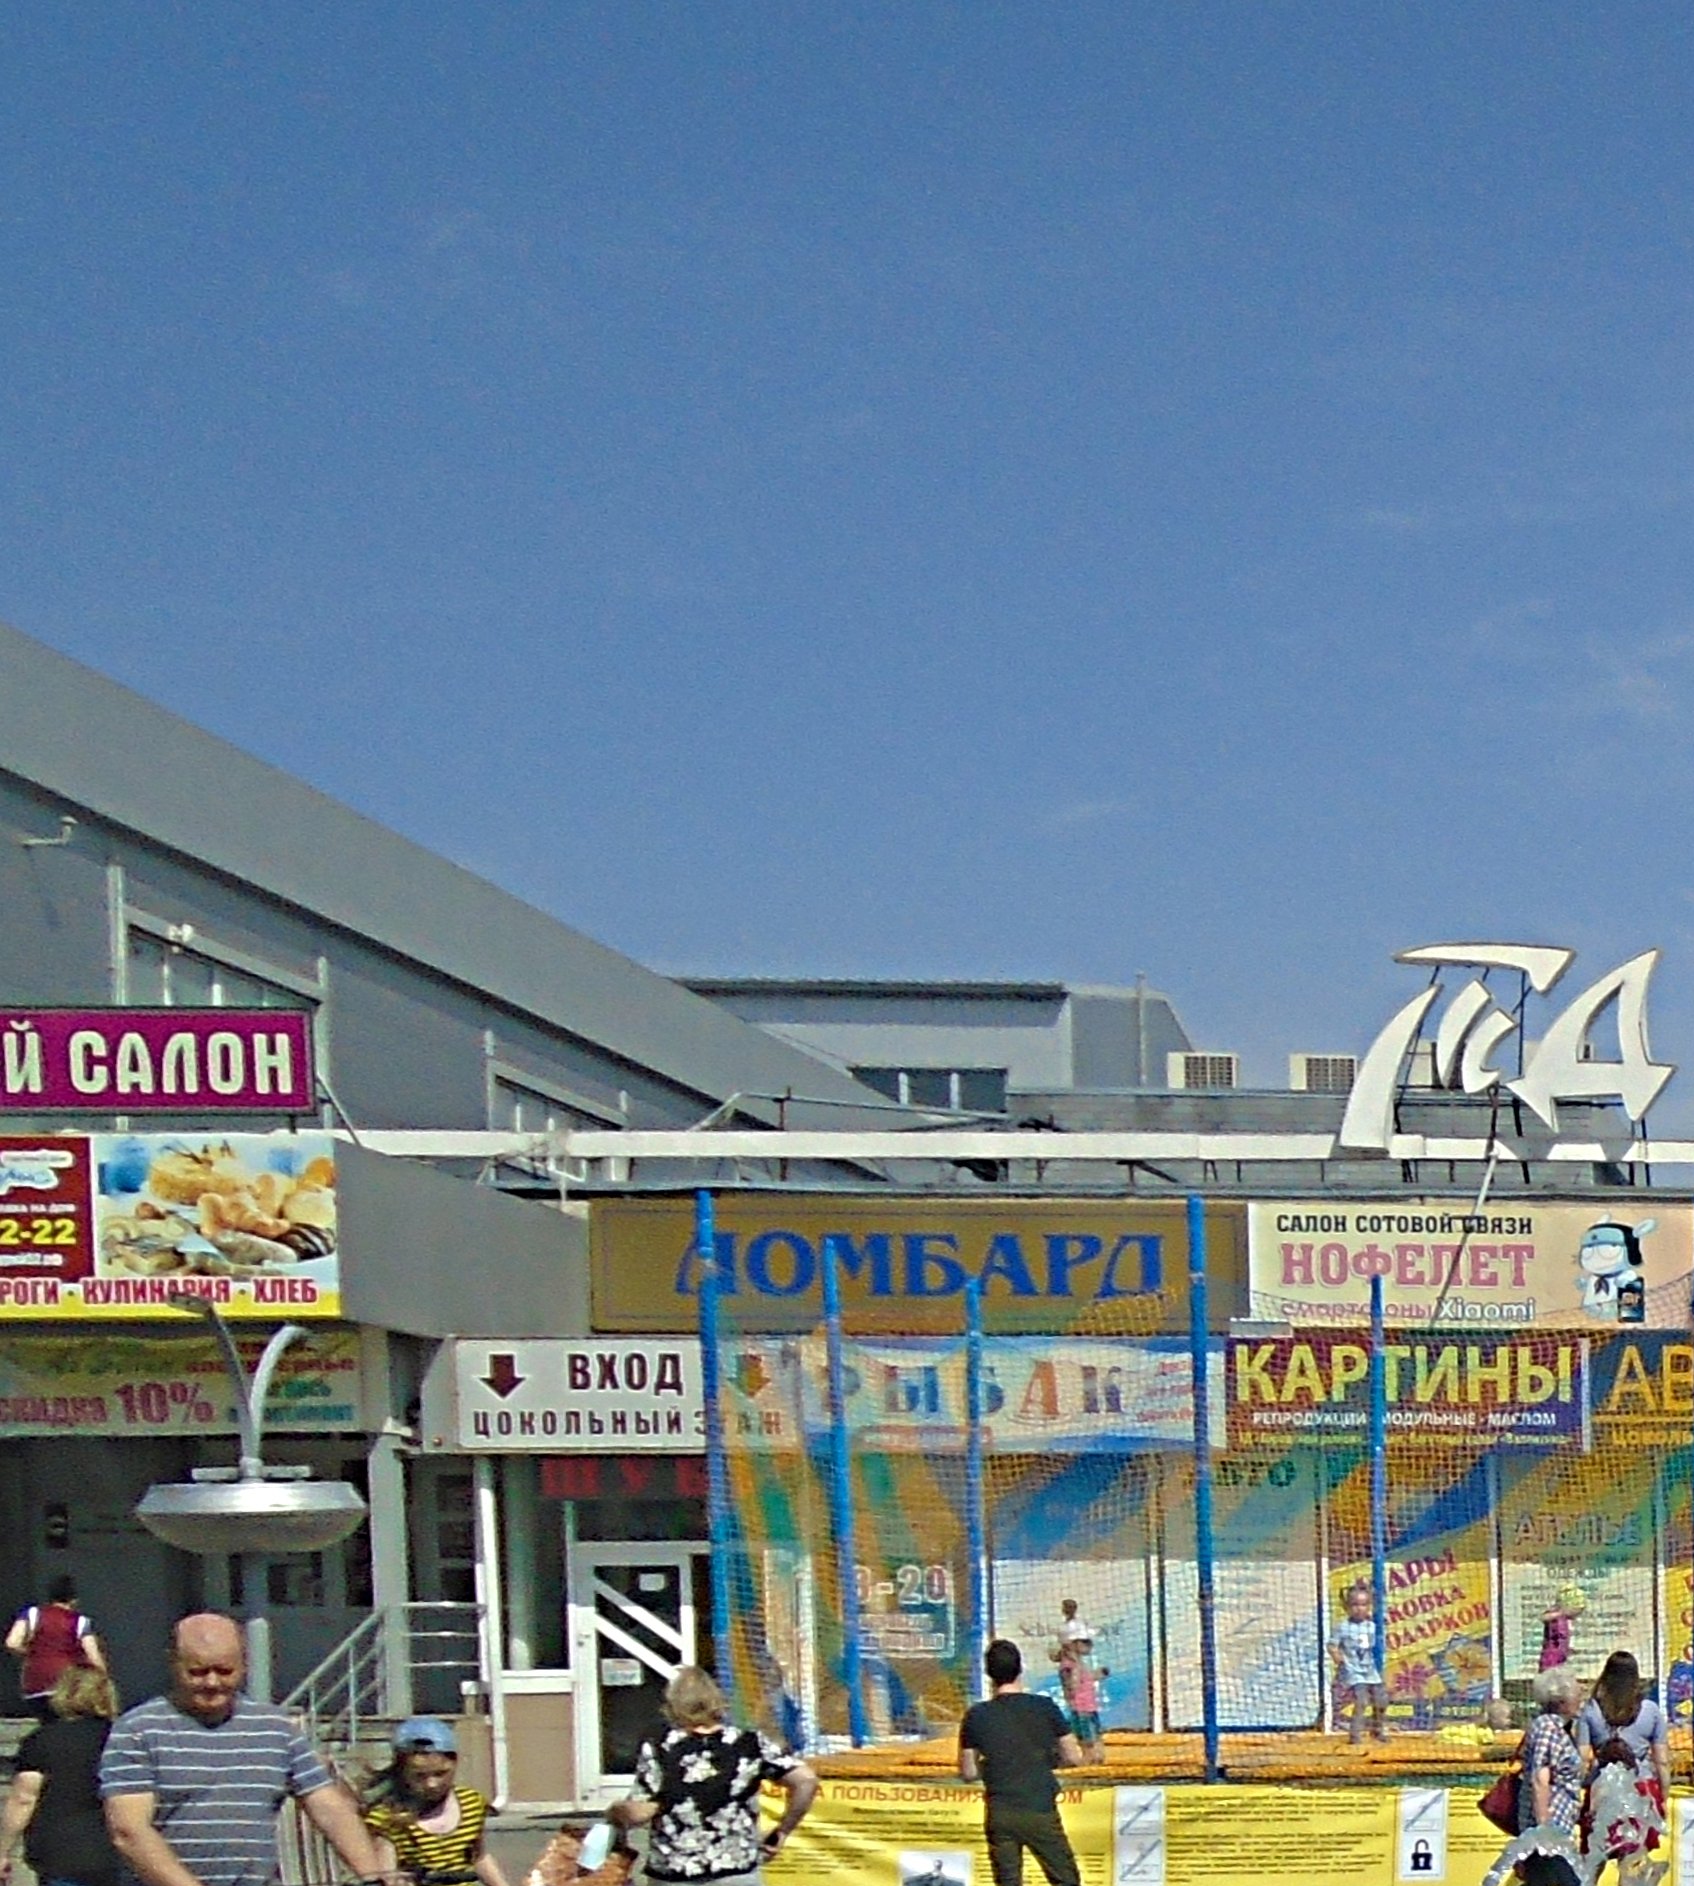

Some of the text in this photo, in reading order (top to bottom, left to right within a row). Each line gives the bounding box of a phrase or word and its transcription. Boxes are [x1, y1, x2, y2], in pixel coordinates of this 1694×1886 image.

[69, 1030, 294, 1096] САЛОН
[0, 1219, 77, 1245] 2-22
[1276, 1210, 1532, 1235] САЛОН СОТОВОЙ СВЯЗИ
[674, 1229, 1164, 1299] ЛОМБАРД
[1279, 1242, 1536, 1290] НОФЕЛЕТ
[82, 1279, 231, 1304] КУЛИНАРИЯ
[253, 1279, 318, 1304] ХЛЕБ
[1281, 1298, 1537, 1323] смартоны Xiaomi
[567, 1353, 684, 1397] ВХОД
[1234, 1344, 1572, 1403] КАРТИНЫ
[115, 1381, 214, 1424] 10%
[473, 1405, 785, 1437] ЦОКОЛЬНЫЙ ЭАЖ
[1253, 1411, 1557, 1430] РЕПРОДУКЦИИ МОДУЛЬНЫЕ МАСЛОМ
[1378, 1602, 1490, 1651] ОДАРКОВ
[831, 1784, 984, 1804] ПОЛЬЗОВАНИЯ
